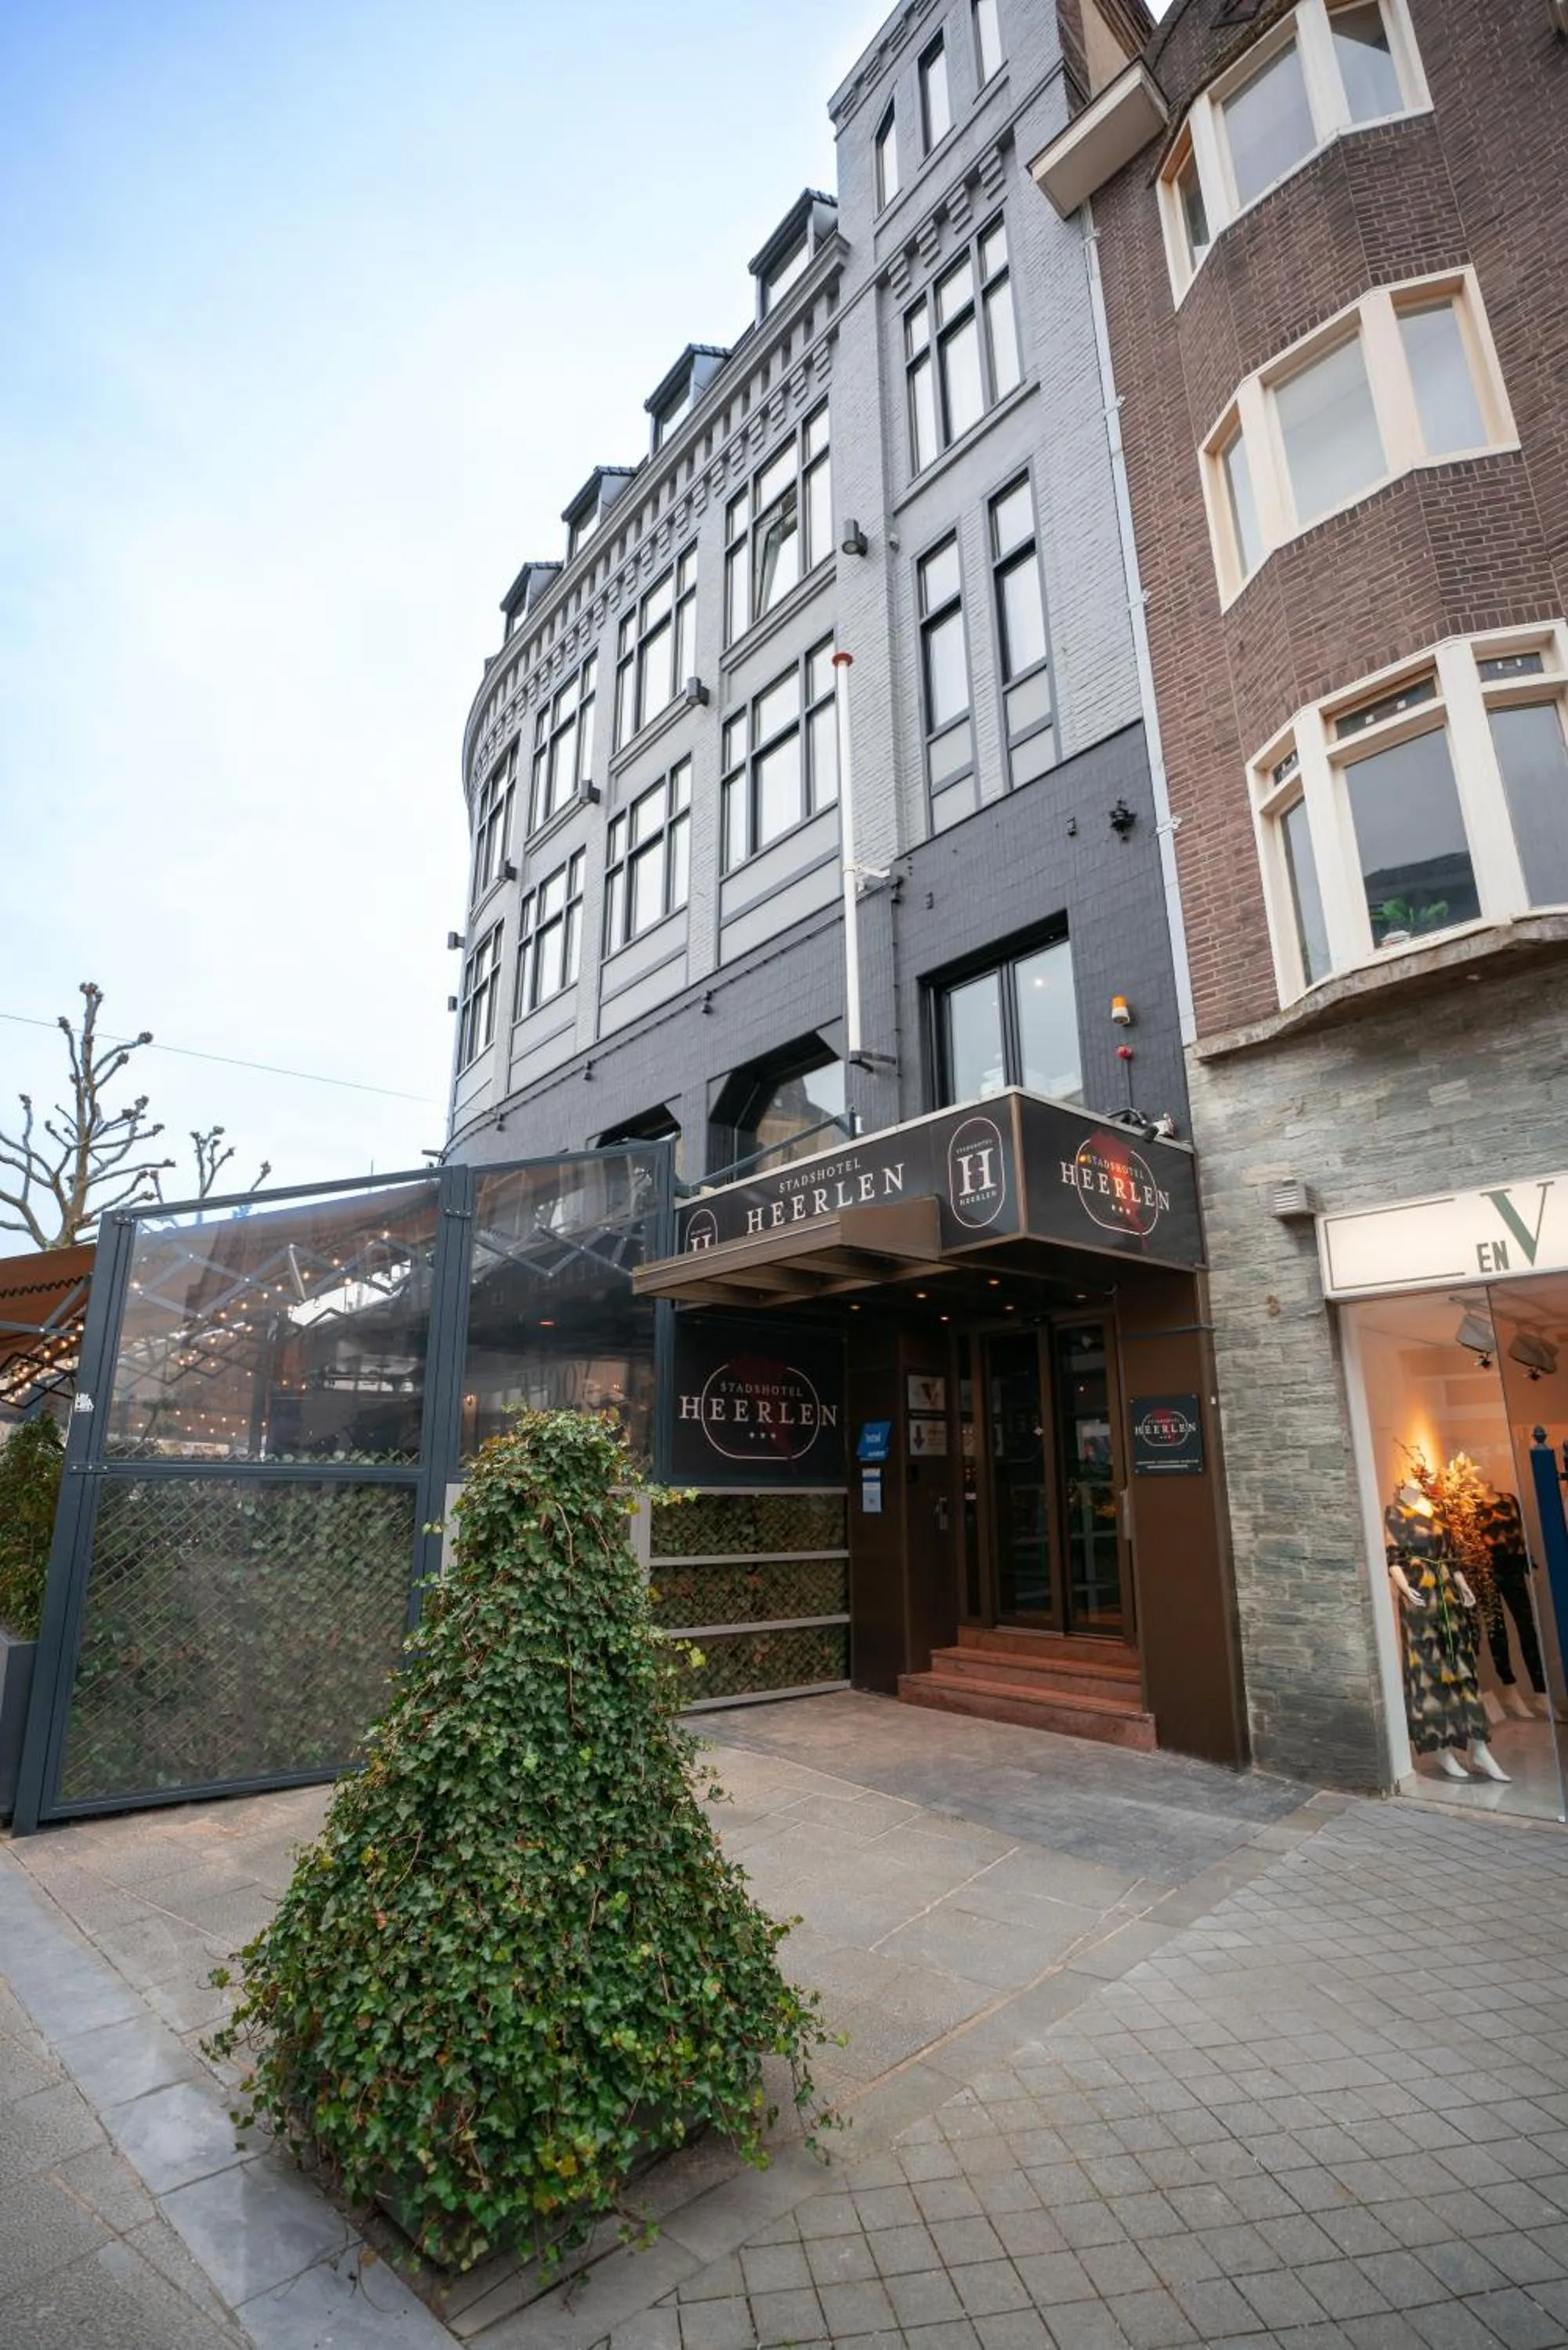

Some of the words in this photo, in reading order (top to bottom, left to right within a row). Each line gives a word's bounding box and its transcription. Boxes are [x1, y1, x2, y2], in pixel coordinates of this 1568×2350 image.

[779, 1158, 861, 1194] STADSHOTEL
[956, 1147, 997, 1197] H
[1060, 1161, 1170, 1211] HEERLEN
[746, 1162, 905, 1235] HEERLEN
[1479, 1180, 1555, 1267] V
[1476, 1240, 1510, 1273] EN
[678, 1395, 838, 1426] HEERLEN
[720, 1382, 804, 1397] STADSHOTEL
